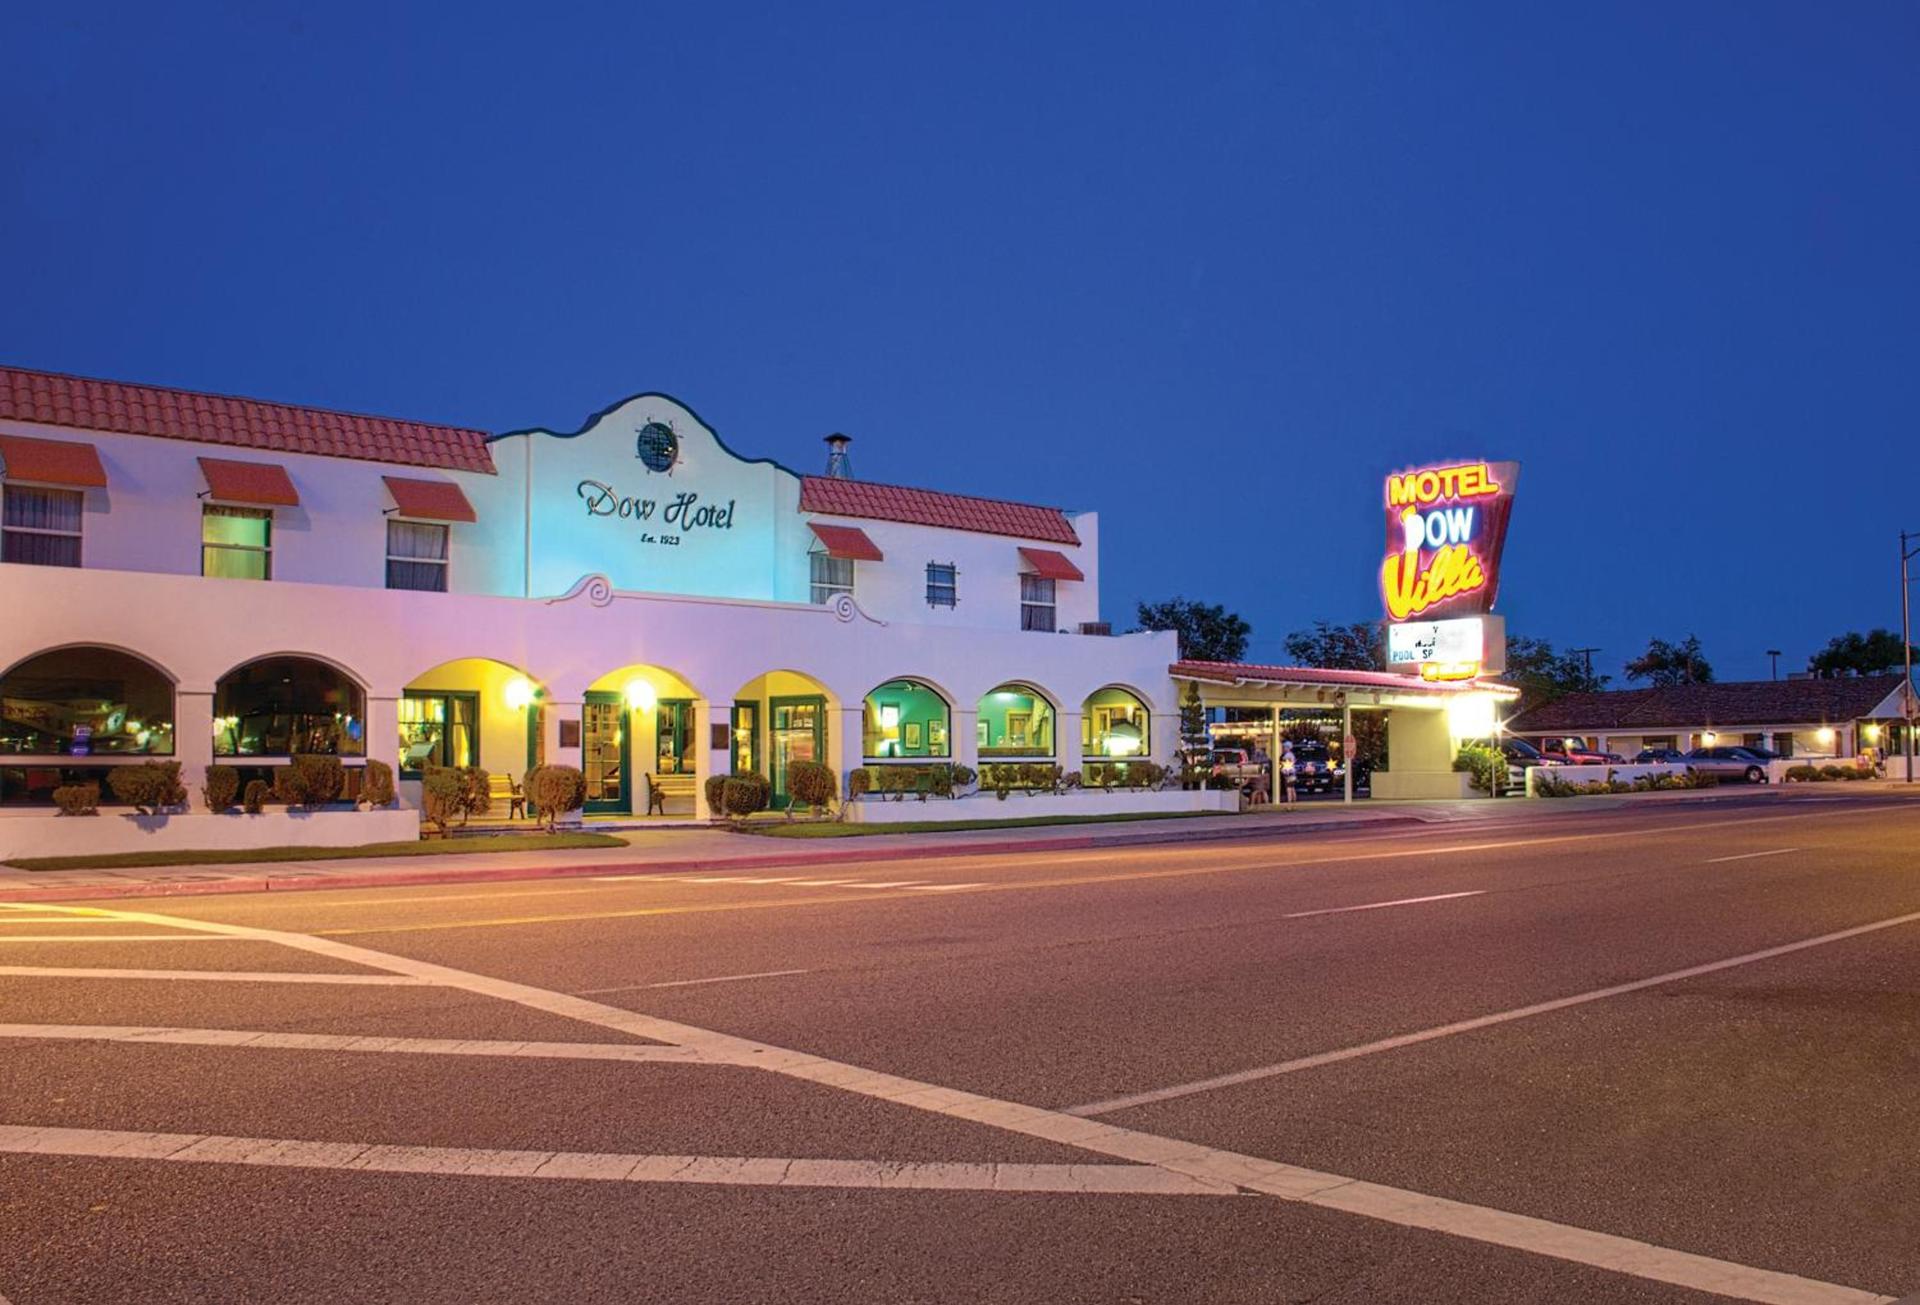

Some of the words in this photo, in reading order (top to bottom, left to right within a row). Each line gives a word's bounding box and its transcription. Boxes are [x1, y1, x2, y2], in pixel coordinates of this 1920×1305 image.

[577, 479, 656, 521] Dow
[664, 492, 736, 531] Hotel
[1389, 464, 1499, 507] MOTEL
[660, 535, 680, 545] 1923
[1383, 540, 1486, 621] Villa
[1392, 649, 1416, 661] POOL
